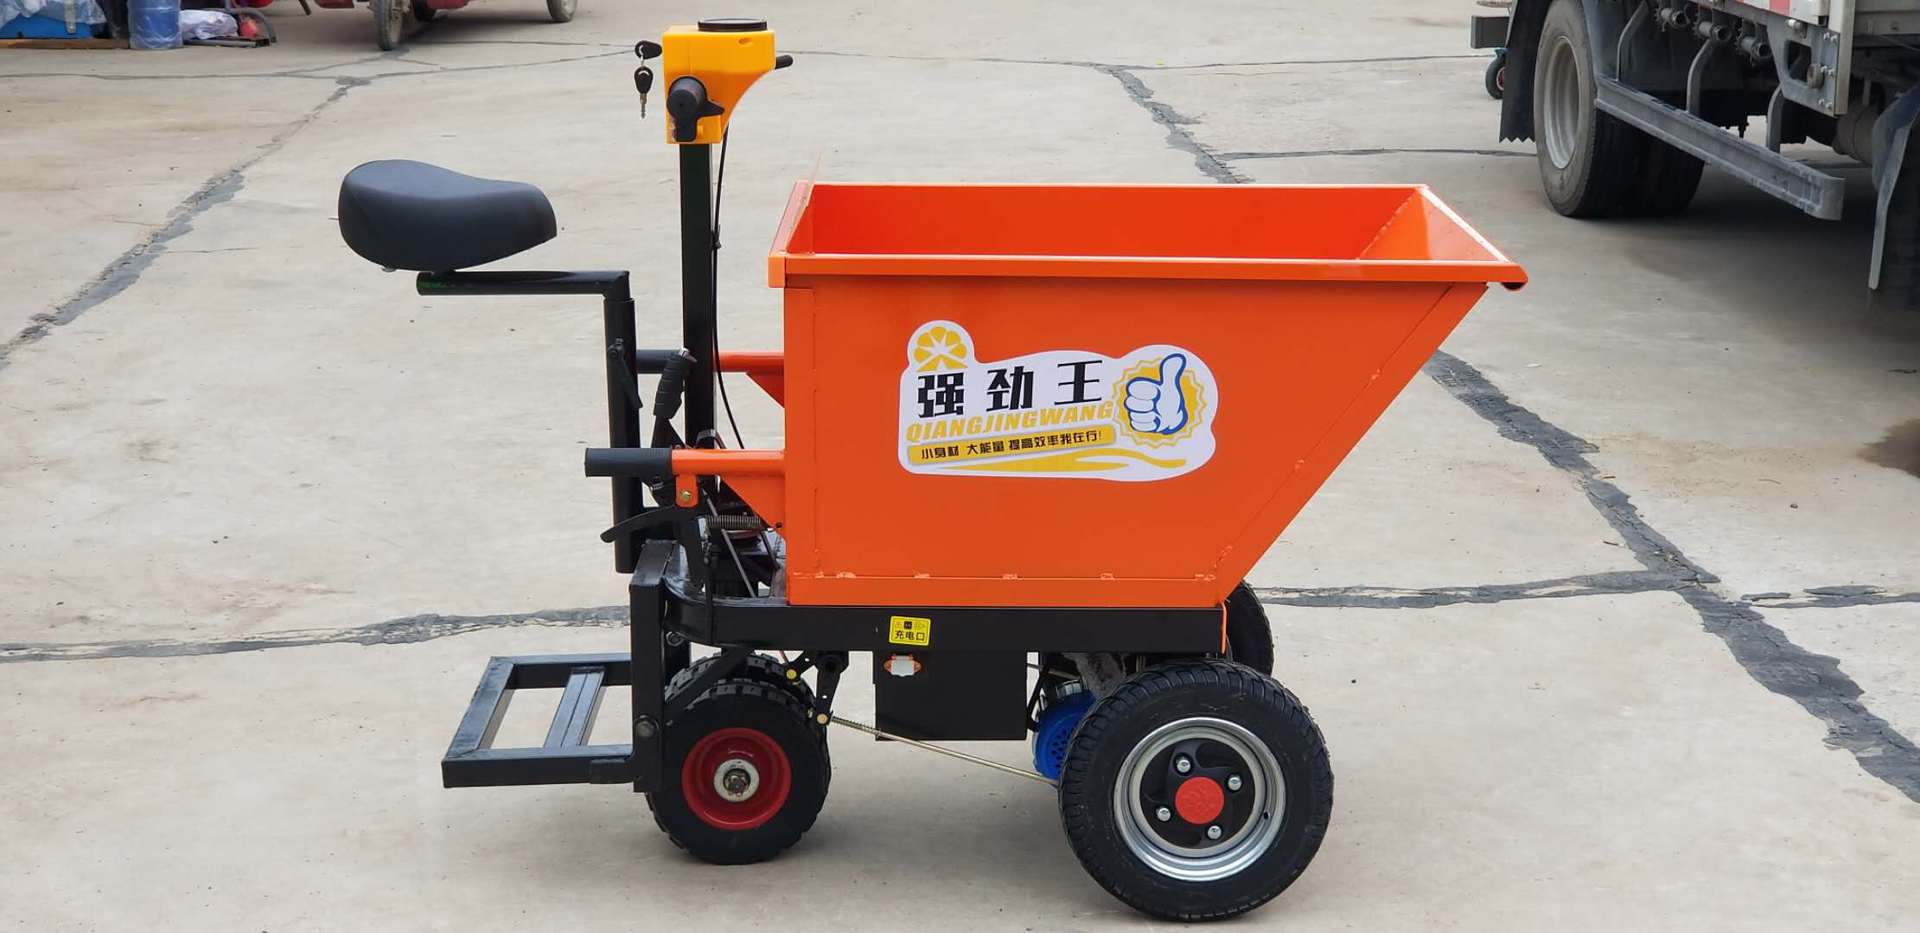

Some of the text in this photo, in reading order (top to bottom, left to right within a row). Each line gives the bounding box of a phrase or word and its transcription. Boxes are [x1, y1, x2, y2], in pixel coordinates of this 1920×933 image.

[918, 360, 1103, 418] 强劲王
[906, 400, 1114, 441] QIANGJINGWANG
[921, 445, 960, 459] 小身材
[966, 441, 1005, 455] 大能量
